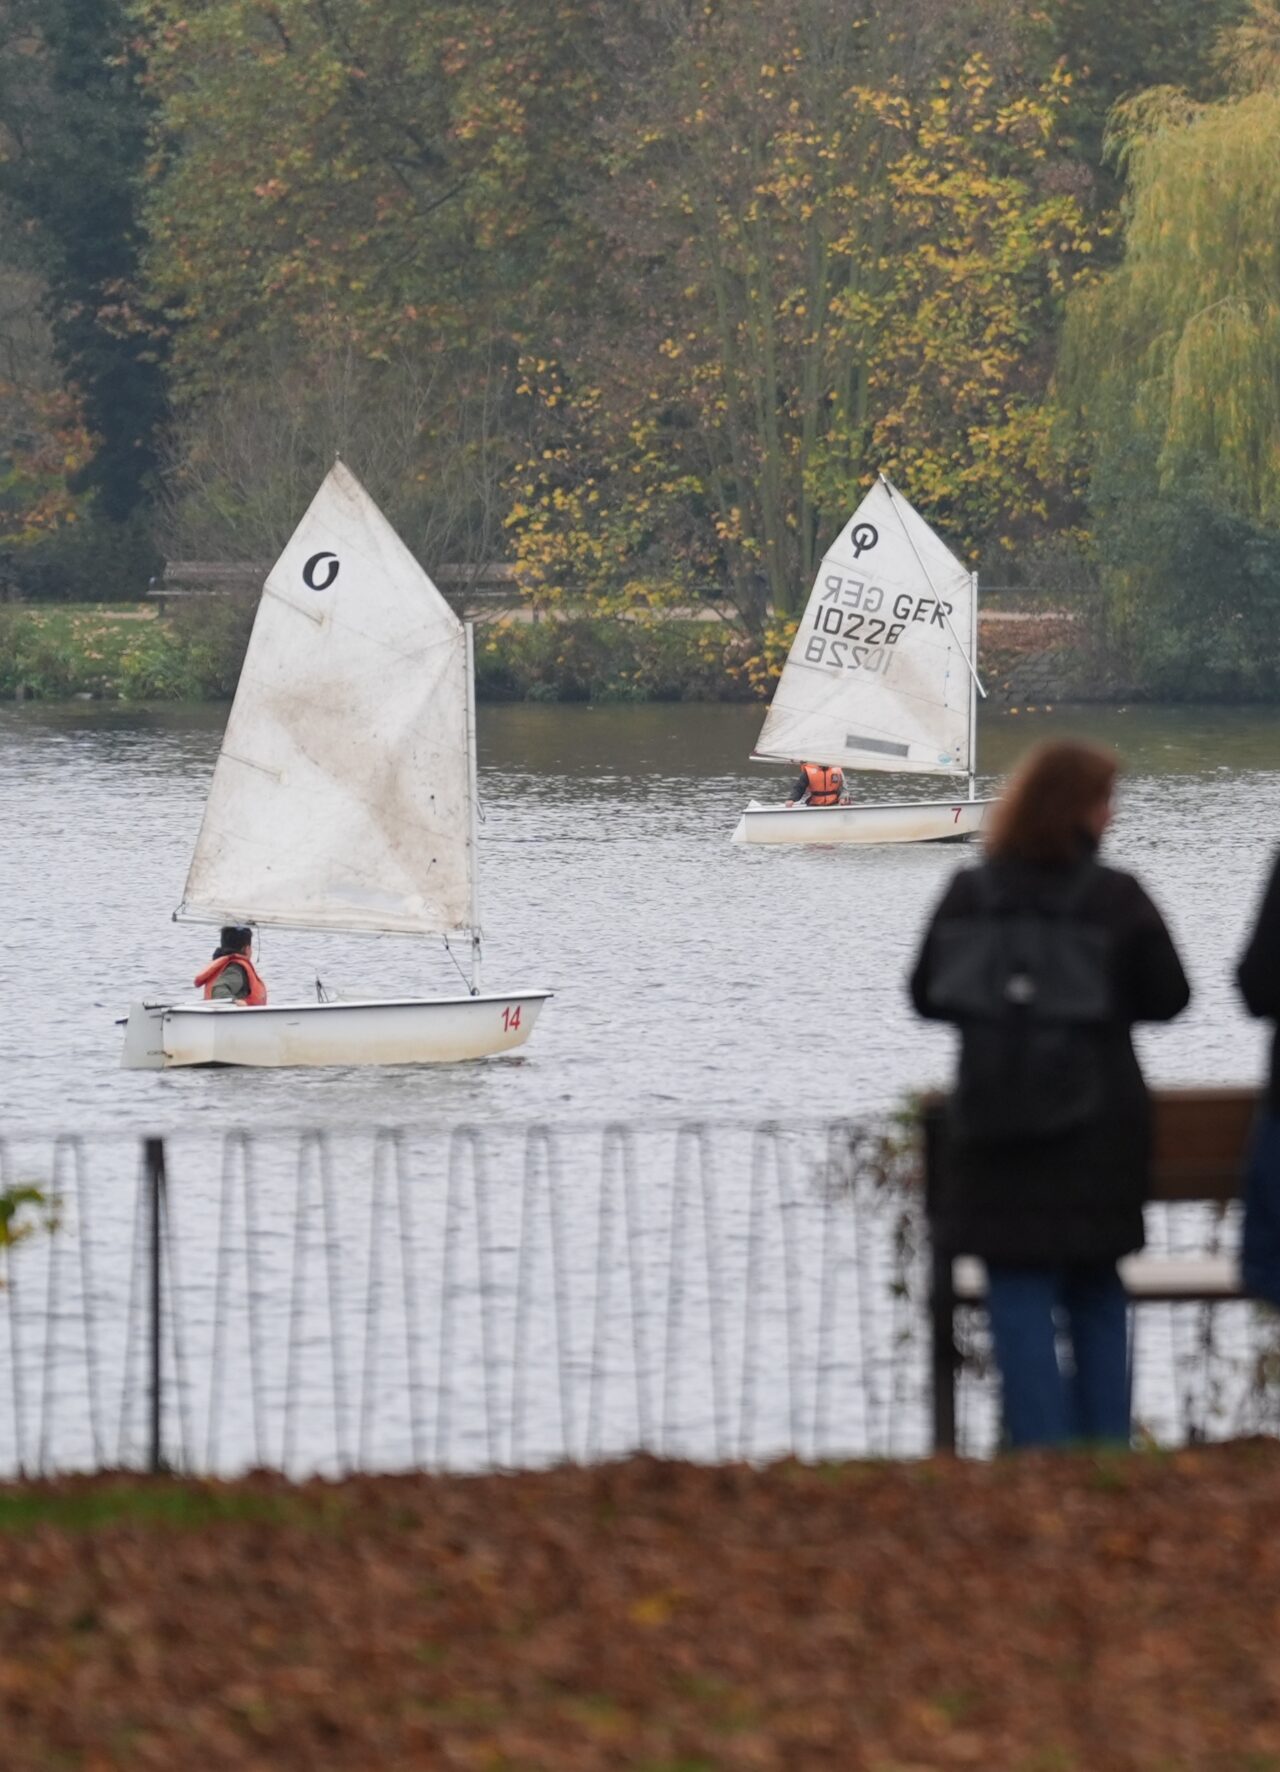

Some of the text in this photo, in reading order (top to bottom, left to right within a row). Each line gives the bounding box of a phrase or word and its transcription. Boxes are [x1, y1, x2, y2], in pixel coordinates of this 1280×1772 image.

[893, 594, 953, 630] GER
[951, 807, 962, 824] 7
[501, 1005, 521, 1032] 14
